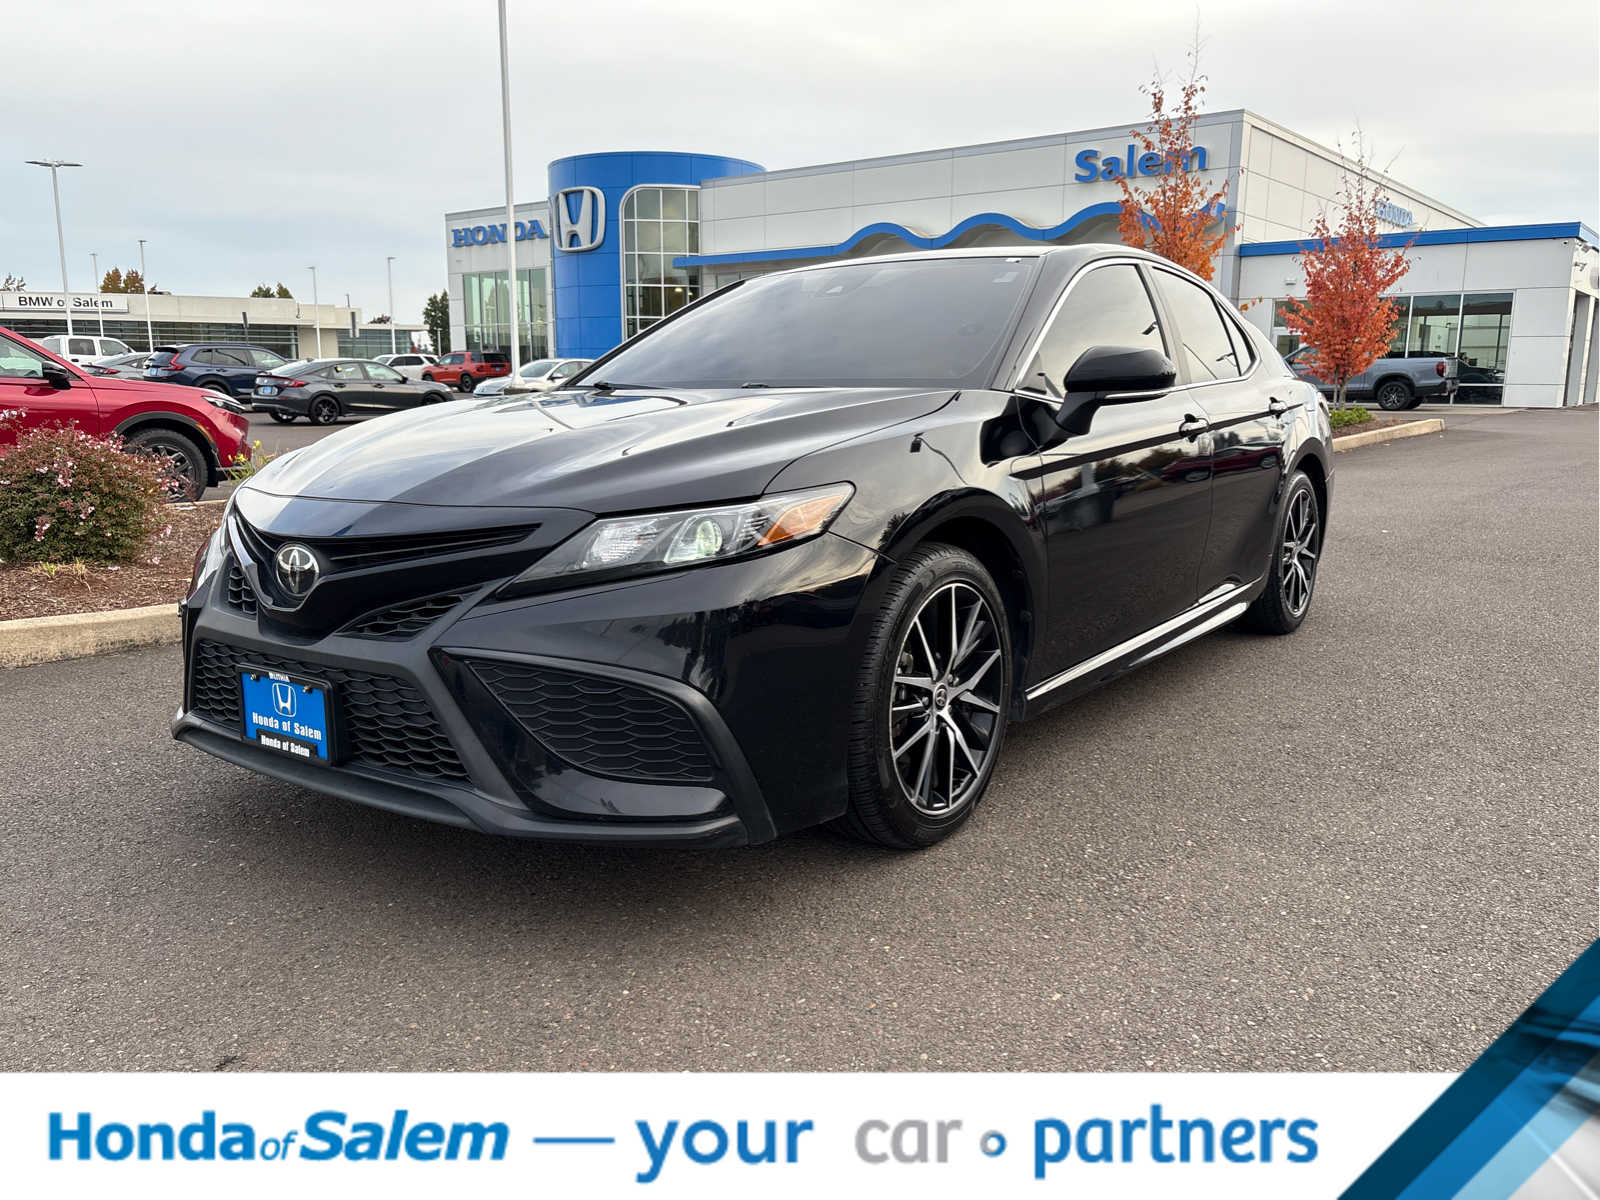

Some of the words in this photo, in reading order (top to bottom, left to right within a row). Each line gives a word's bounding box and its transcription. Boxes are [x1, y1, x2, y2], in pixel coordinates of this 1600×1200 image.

[451, 220, 548, 247] HONDA
[18, 296, 53, 307] BMW
[73, 297, 113, 308] Salem
[252, 712, 279, 729] Honda
[282, 721, 291, 732] of
[294, 722, 322, 741] Salem
[260, 734, 281, 749] Honda
[282, 741, 289, 752] of
[290, 742, 310, 758] Salem
